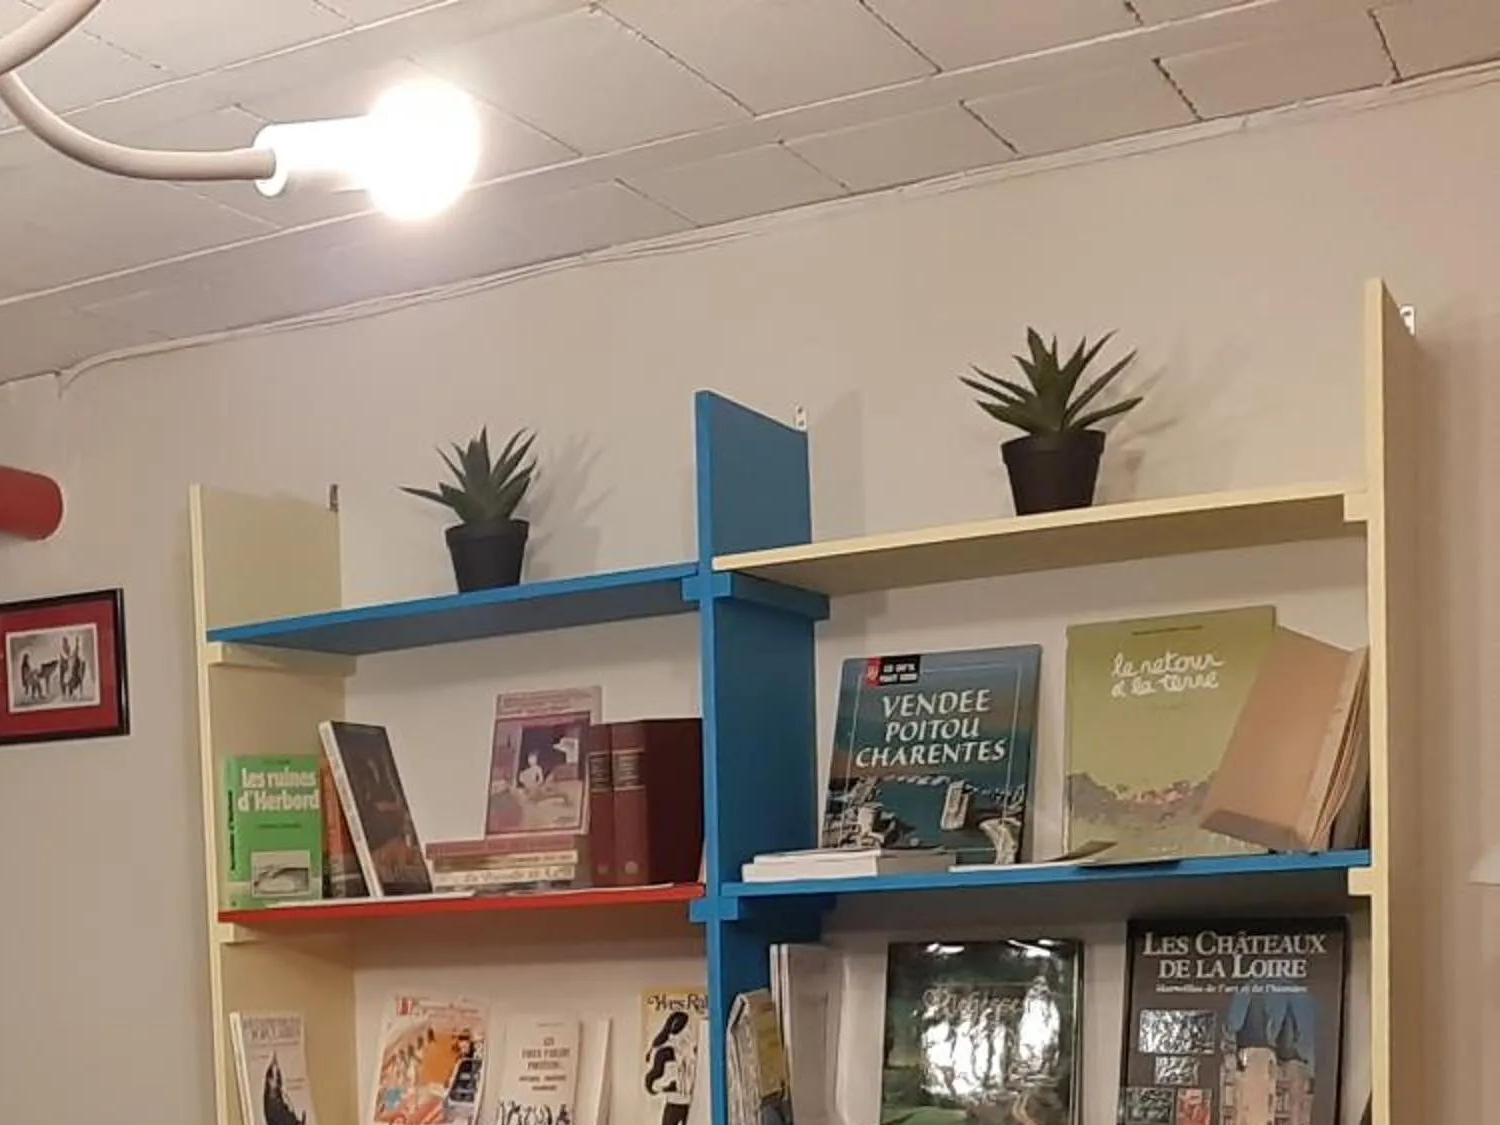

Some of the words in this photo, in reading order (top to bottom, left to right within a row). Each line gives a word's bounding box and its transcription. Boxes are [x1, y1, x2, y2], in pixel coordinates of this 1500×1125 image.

[1141, 648, 1225, 675] retour
[1130, 675, 1158, 697] la
[1158, 670, 1220, 692] terre
[882, 689, 991, 718] VENDEE
[885, 717, 981, 743] POITOU
[855, 738, 1008, 768] CHARENTES
[242, 767, 266, 789] Les
[266, 766, 318, 789] ruines
[238, 789, 320, 812] d'Herbord
[1143, 932, 1189, 955] LES
[1195, 930, 1328, 956] CHÂTEAUX
[1158, 959, 1192, 979] DE
[1196, 959, 1227, 979] LA
[1231, 953, 1308, 979] LOIRE
